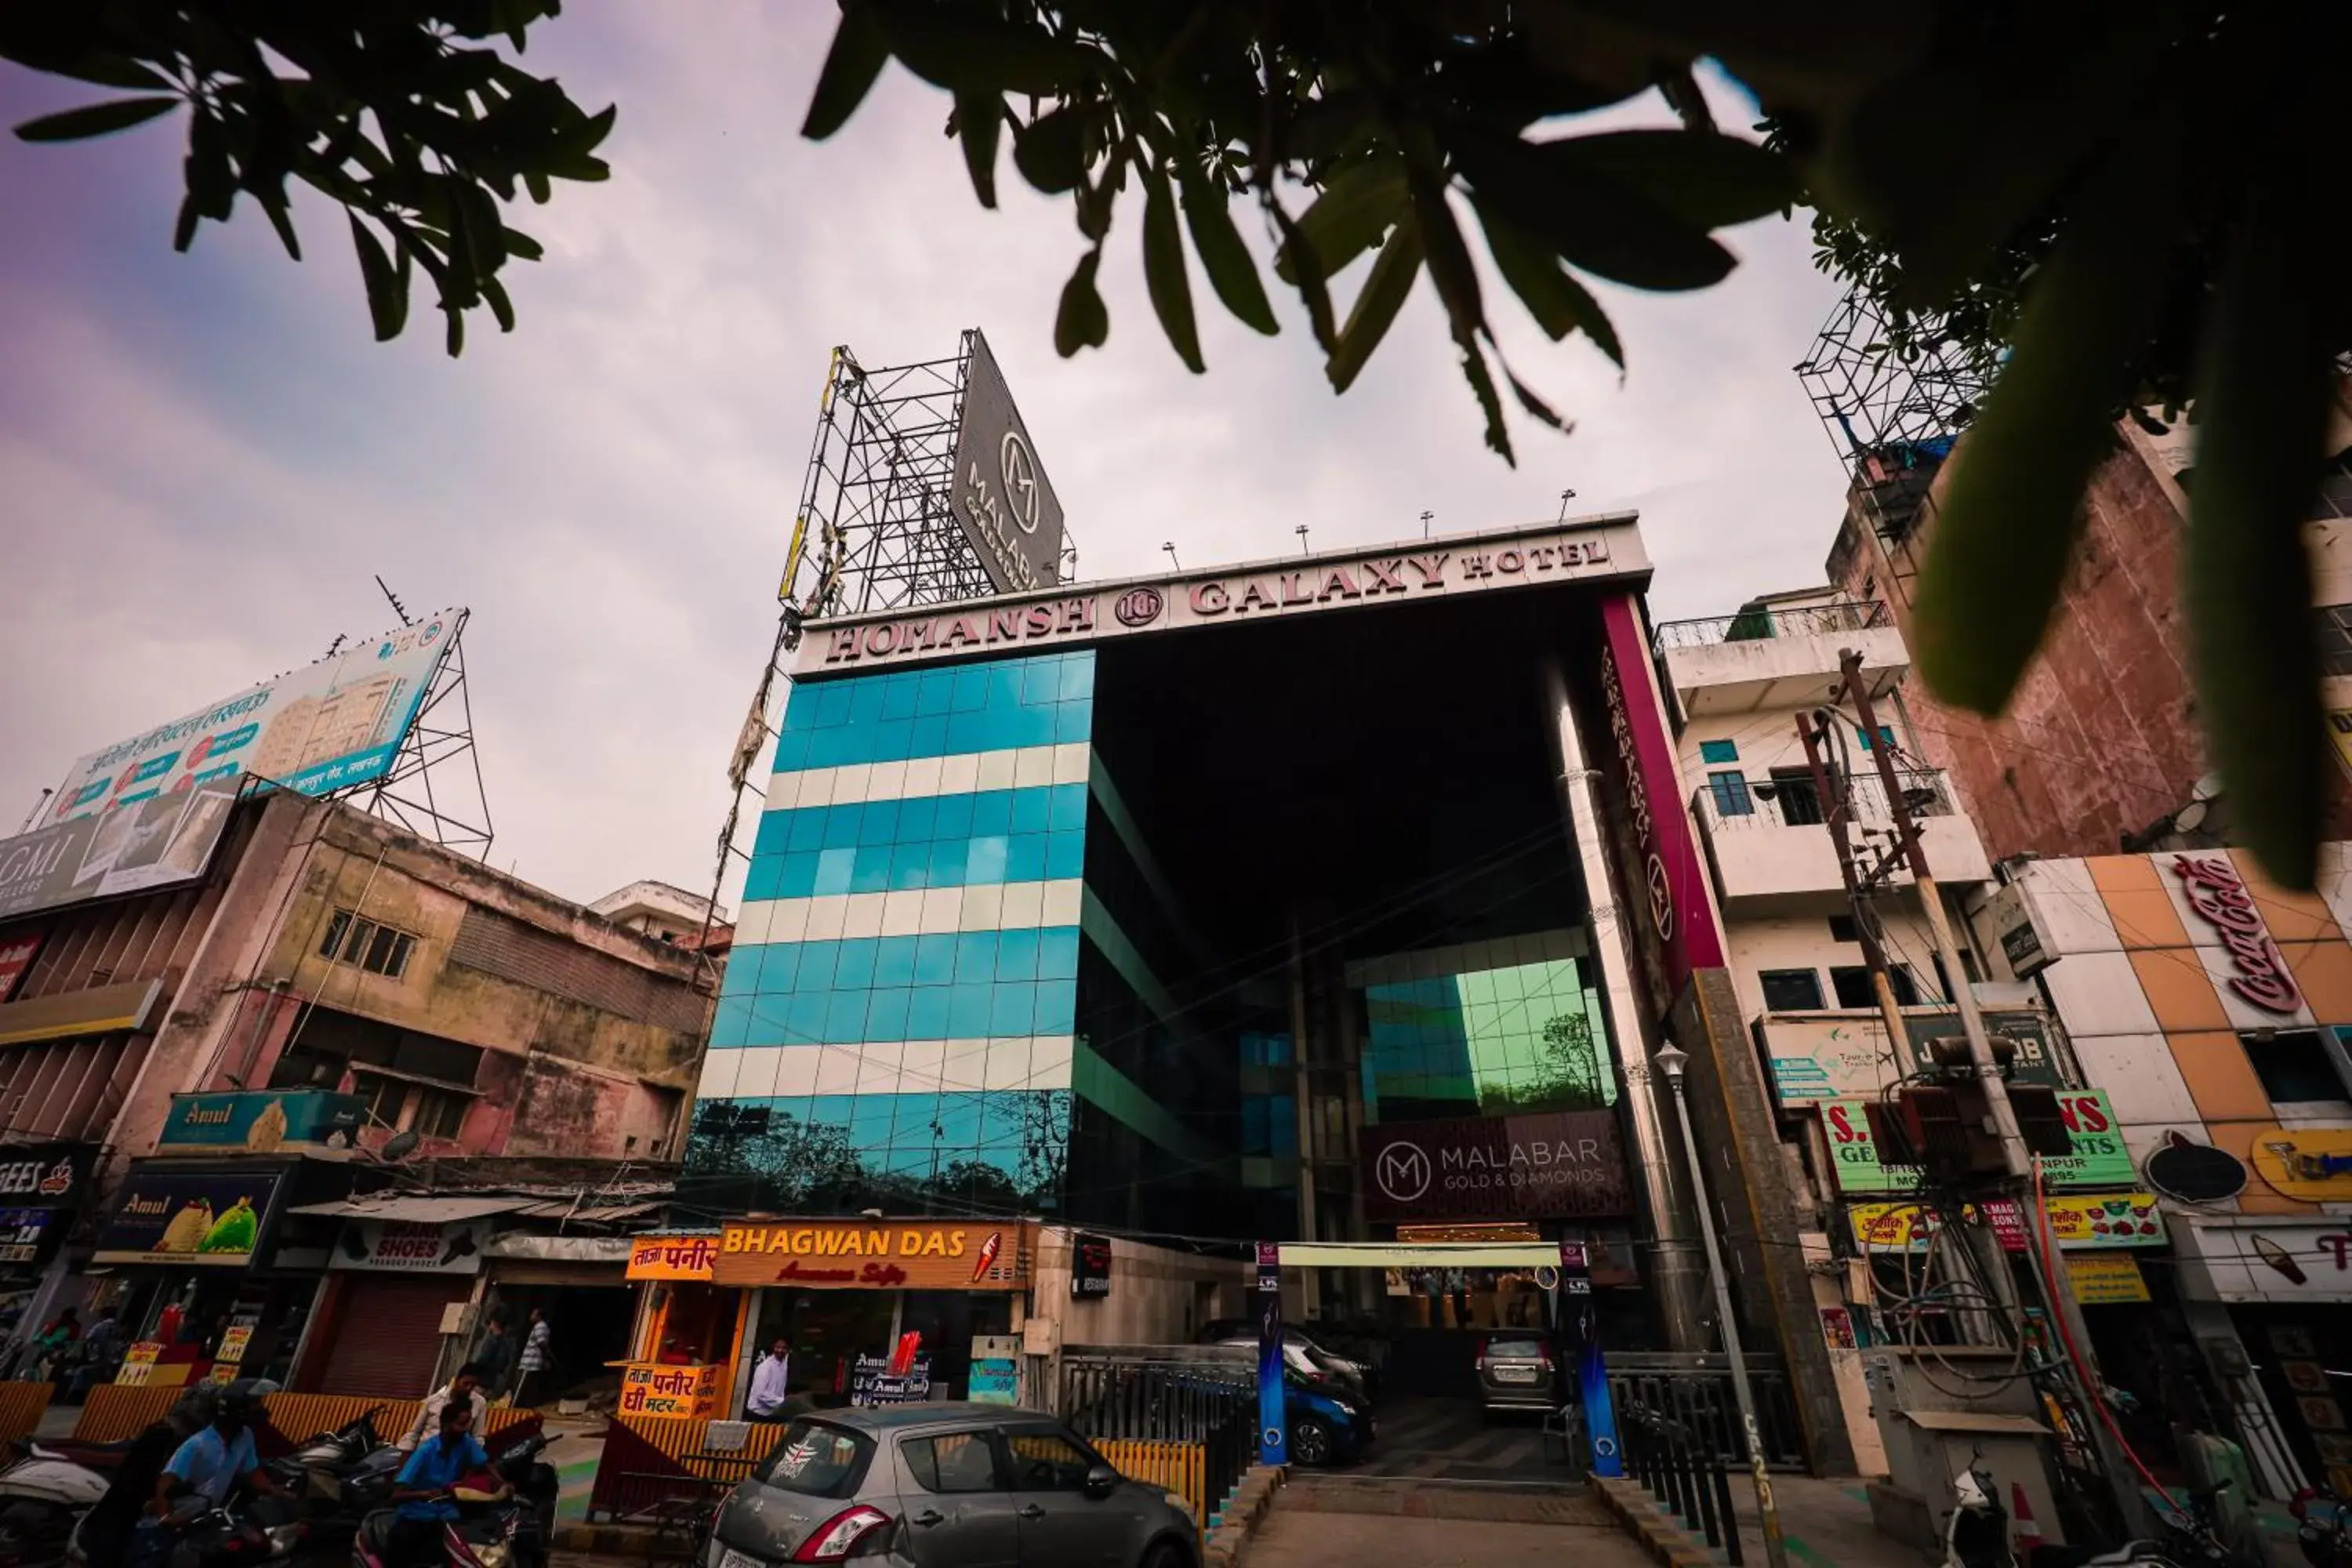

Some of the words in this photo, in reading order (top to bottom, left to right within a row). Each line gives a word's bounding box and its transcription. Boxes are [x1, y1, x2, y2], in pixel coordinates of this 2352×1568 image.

[826, 598, 1095, 662] HOMANSH
[1189, 553, 1450, 615] GALAXY
[1461, 541, 1608, 579] HOTEL
[183, 1100, 234, 1125] Amul
[1441, 1139, 1601, 1170] MALABAR
[1444, 1173, 1490, 1189] GOLD
[1494, 1174, 1506, 1188] &
[1510, 1168, 1606, 1188] DIAMONDS
[122, 1192, 172, 1216] Amul
[376, 1239, 440, 1259] SHOES
[723, 1228, 891, 1255] BHAGWAN
[899, 1229, 967, 1258] DAS
[653, 1371, 697, 1397] पनीर
[624, 1388, 647, 1411] घी
[645, 1397, 677, 1414] मटर
